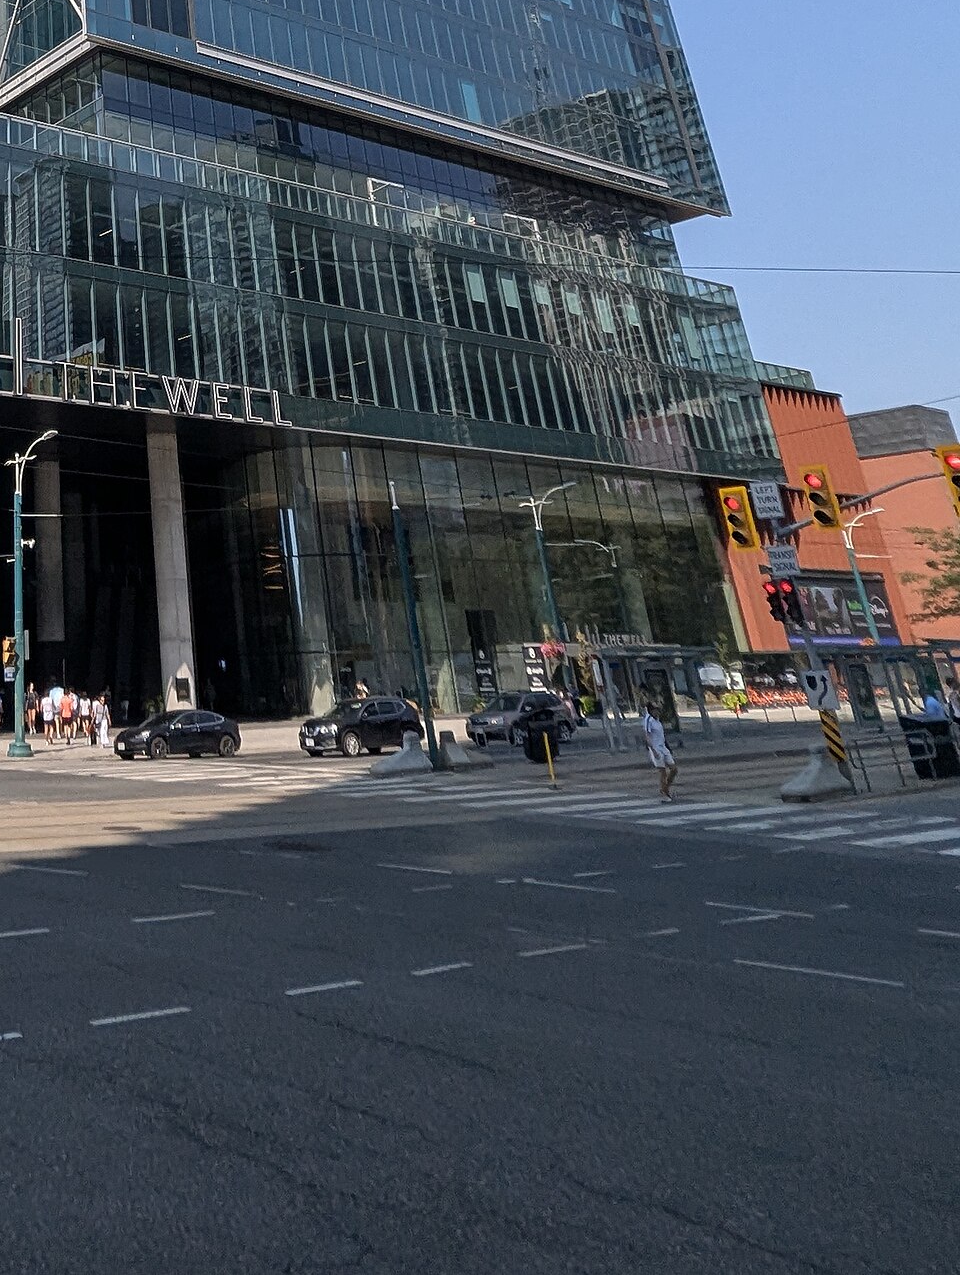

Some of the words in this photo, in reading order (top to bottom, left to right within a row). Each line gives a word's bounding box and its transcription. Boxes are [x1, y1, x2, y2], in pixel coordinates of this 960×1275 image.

[55, 361, 152, 411] THE
[161, 375, 293, 427] WELL
[754, 485, 774, 495] LEFT
[756, 495, 778, 504] TURN
[758, 505, 781, 514] SIGNAL
[602, 633, 622, 646] THE
